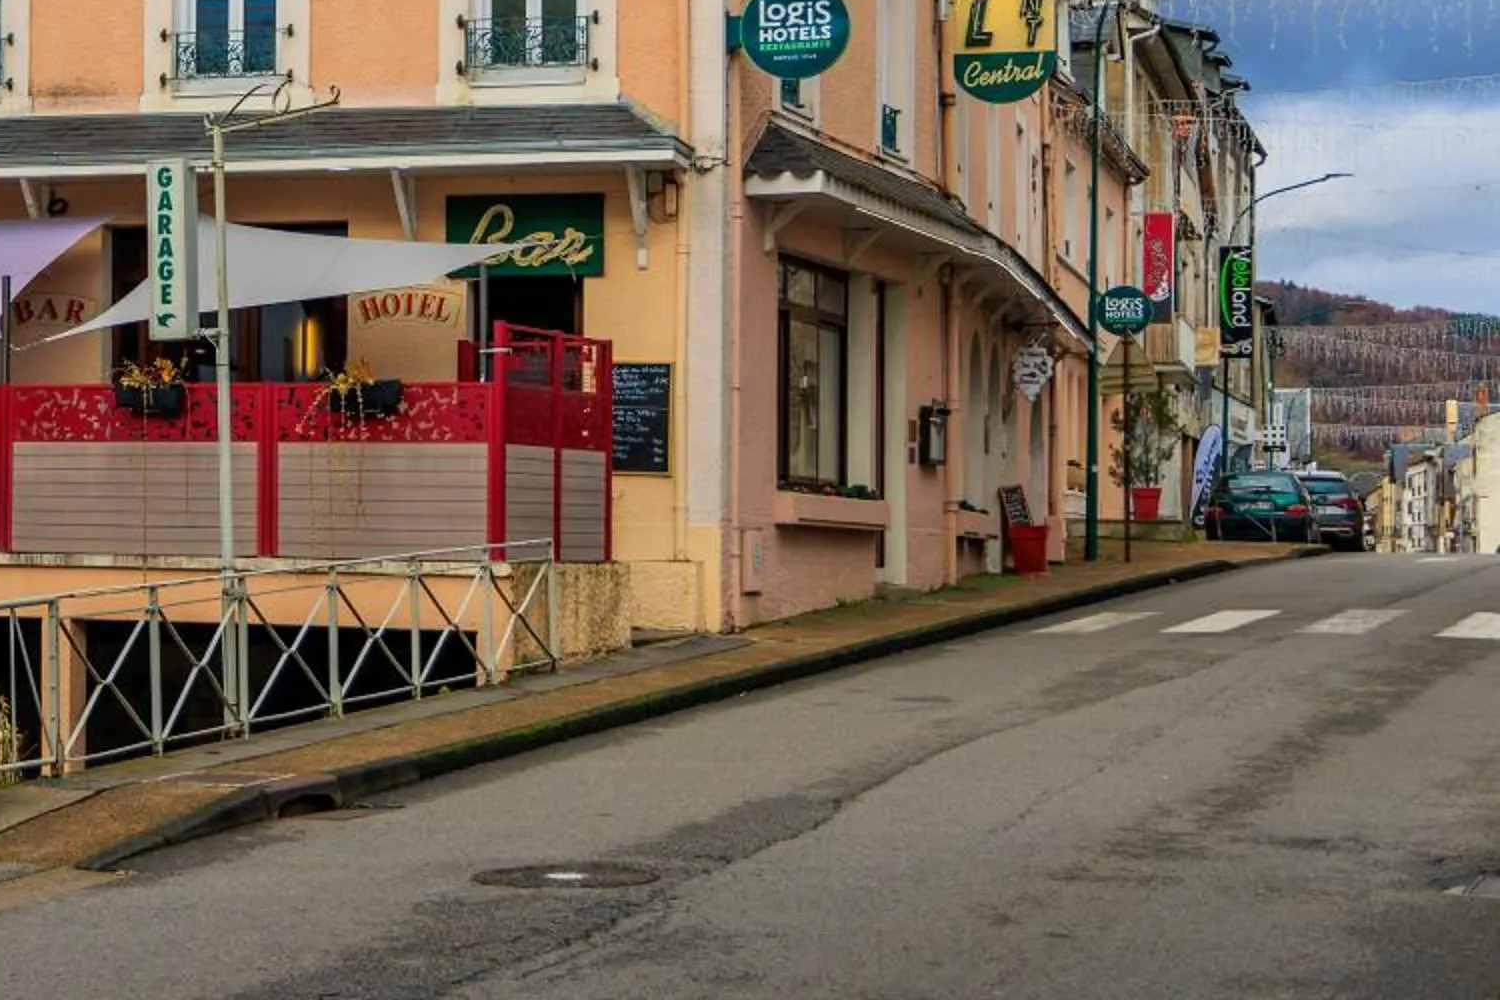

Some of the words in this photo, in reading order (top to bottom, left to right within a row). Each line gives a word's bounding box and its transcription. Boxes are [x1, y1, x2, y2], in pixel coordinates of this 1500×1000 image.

[759, 25, 832, 42] HOTELS
[963, 53, 1045, 88] Central
[157, 166, 174, 305] GARAGE
[468, 203, 594, 268] Bar
[14, 297, 85, 326] BAR
[359, 292, 451, 325] HOTEL
